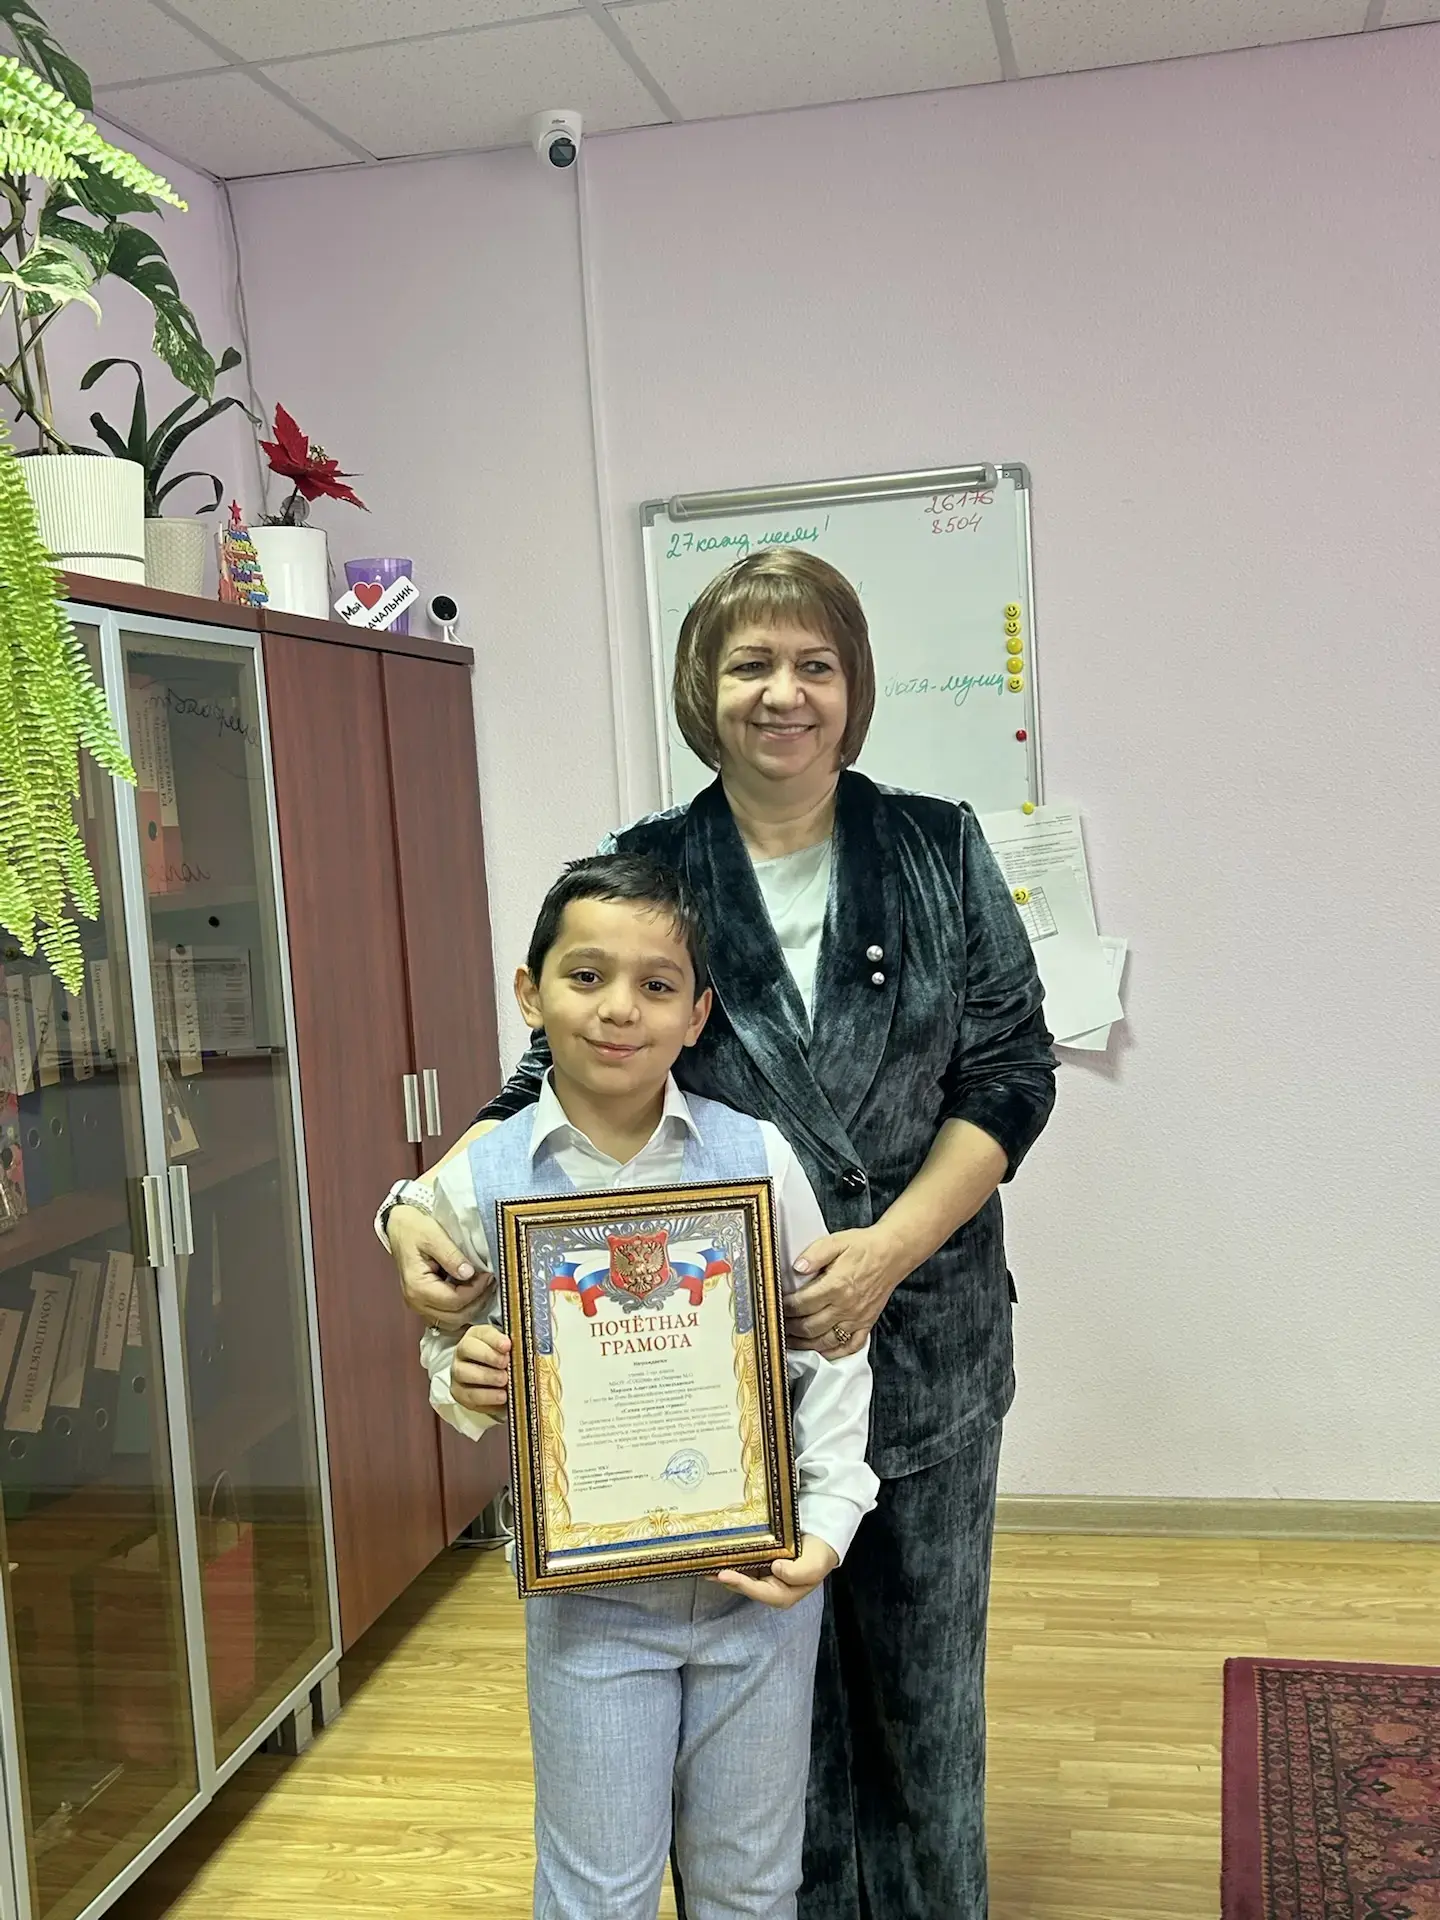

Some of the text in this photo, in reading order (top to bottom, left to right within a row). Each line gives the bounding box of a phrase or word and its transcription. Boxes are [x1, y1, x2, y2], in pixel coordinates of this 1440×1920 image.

[924, 489, 994, 514] 26176
[932, 512, 983, 534] 8504
[341, 602, 362, 620] Мой
[365, 585, 414, 629] АЧАЛЬНИК
[589, 1312, 700, 1338] ПОЧЁТНАЯ
[600, 1333, 692, 1356] ГРАМОТА
